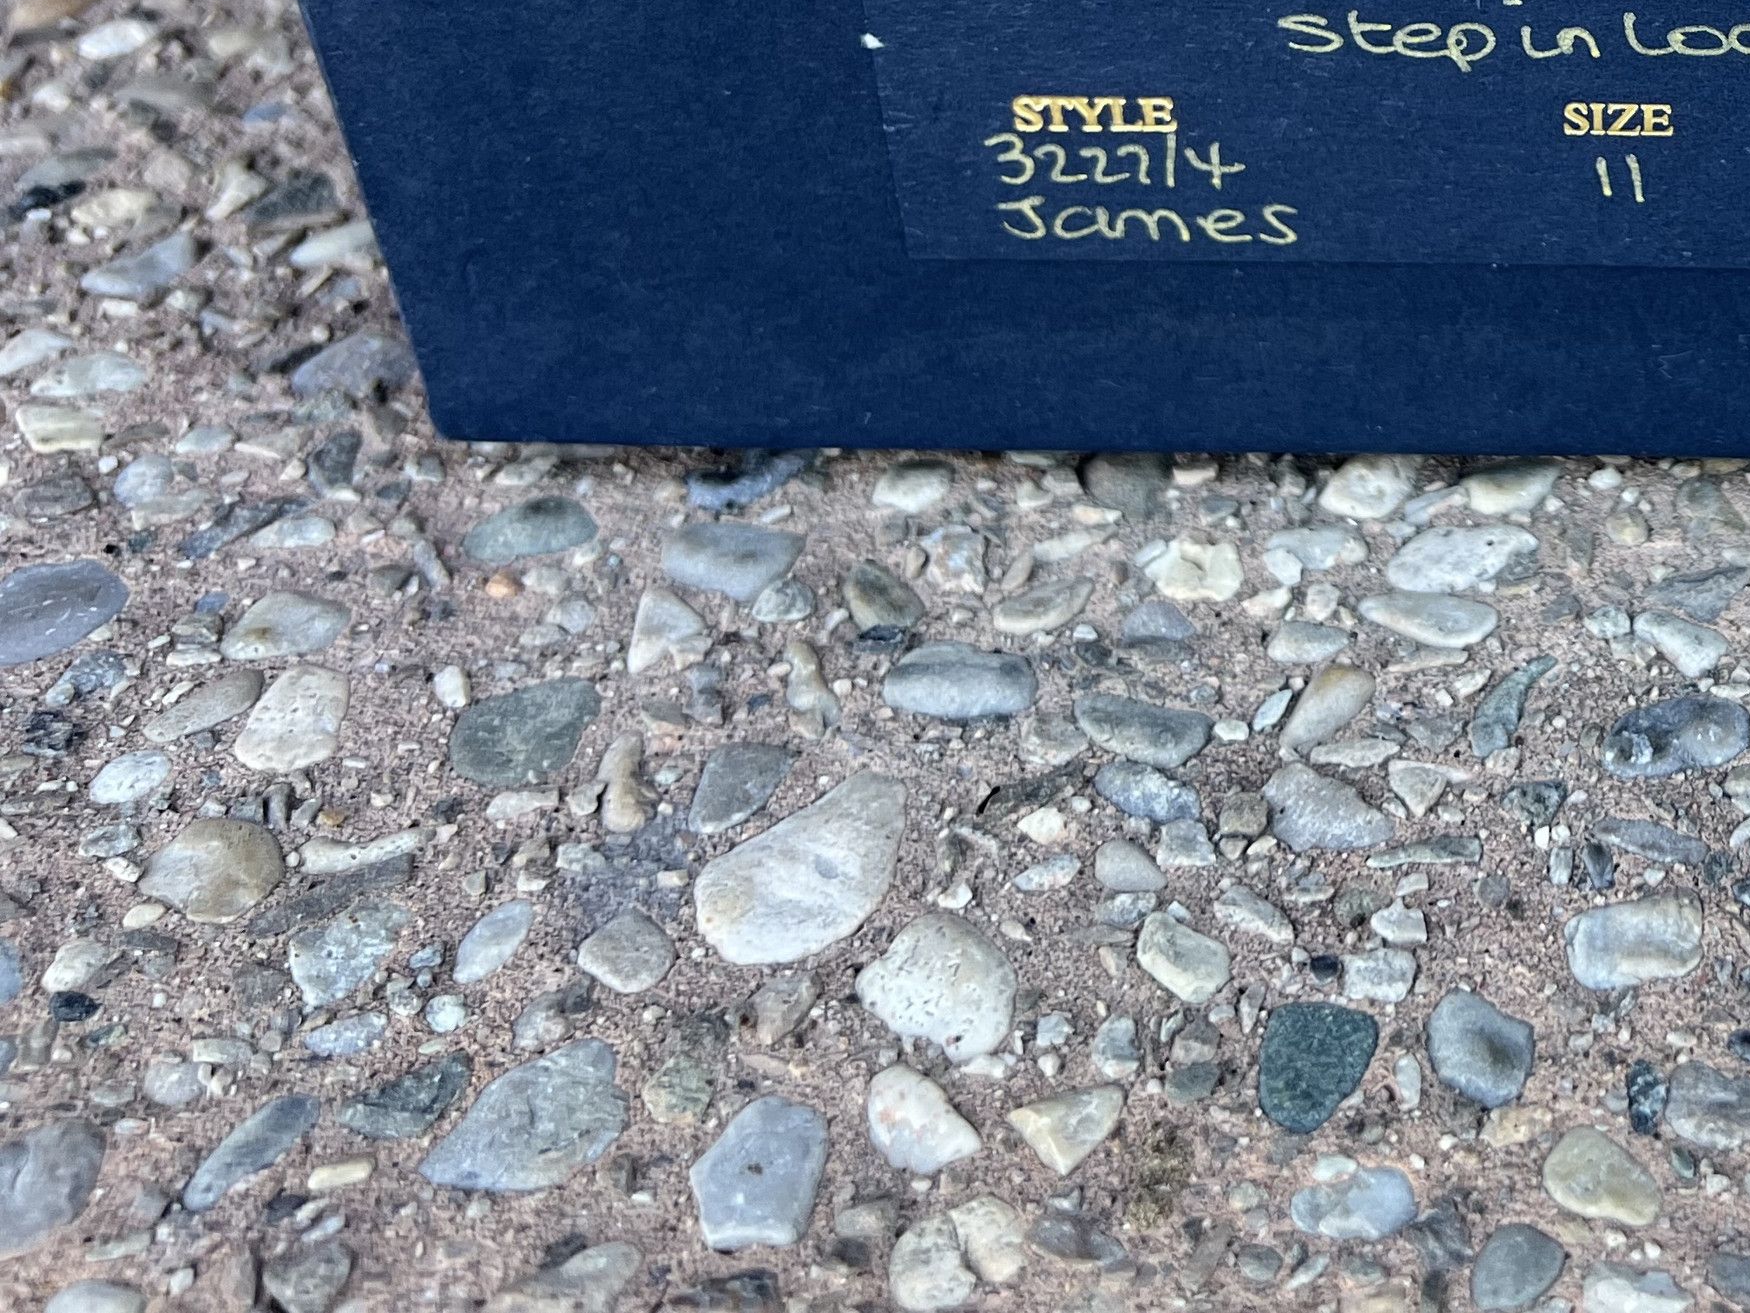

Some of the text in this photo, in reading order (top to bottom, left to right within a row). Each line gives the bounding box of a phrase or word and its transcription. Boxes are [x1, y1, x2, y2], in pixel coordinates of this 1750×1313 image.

[1277, 10, 1496, 72] step
[1013, 96, 1178, 133] STYLE
[1563, 102, 1674, 137] SIZE
[1596, 154, 1645, 203] 11
[998, 196, 1297, 245] James
